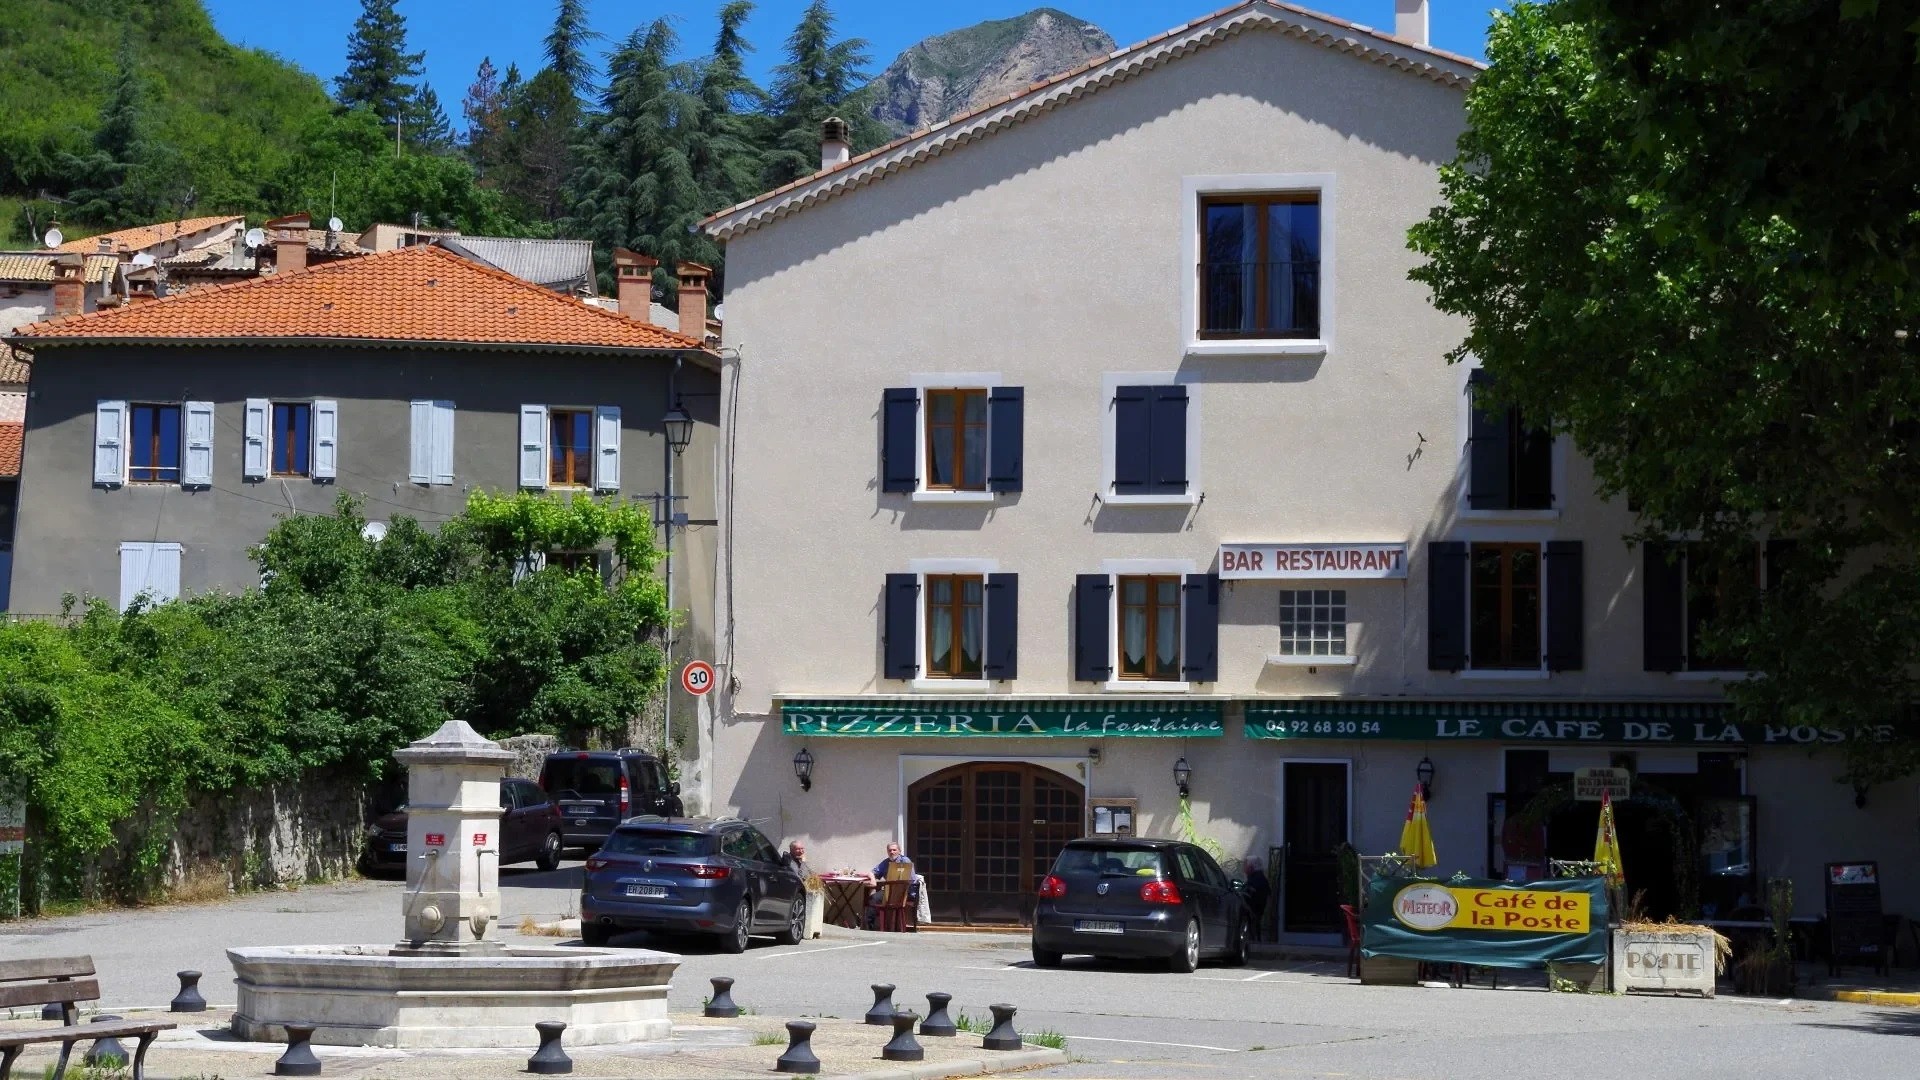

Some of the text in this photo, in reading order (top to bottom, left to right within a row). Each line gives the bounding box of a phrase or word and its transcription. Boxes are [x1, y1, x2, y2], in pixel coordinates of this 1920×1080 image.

[1222, 550, 1404, 571] BAR RESTAURANT
[690, 671, 707, 684] 30
[786, 713, 1221, 734] PIZZERIA La Fontaine
[1265, 719, 1380, 734] 04 92 68 30 54
[1435, 718, 1483, 737] LE
[1501, 718, 1604, 739] CAFE
[1623, 721, 1675, 741] DE
[1694, 723, 1744, 741] LA
[1402, 898, 1452, 916] METEOR
[1473, 892, 1578, 911] Café de
[1471, 911, 1581, 930] la Poste
[1627, 952, 1701, 970] POSTE
